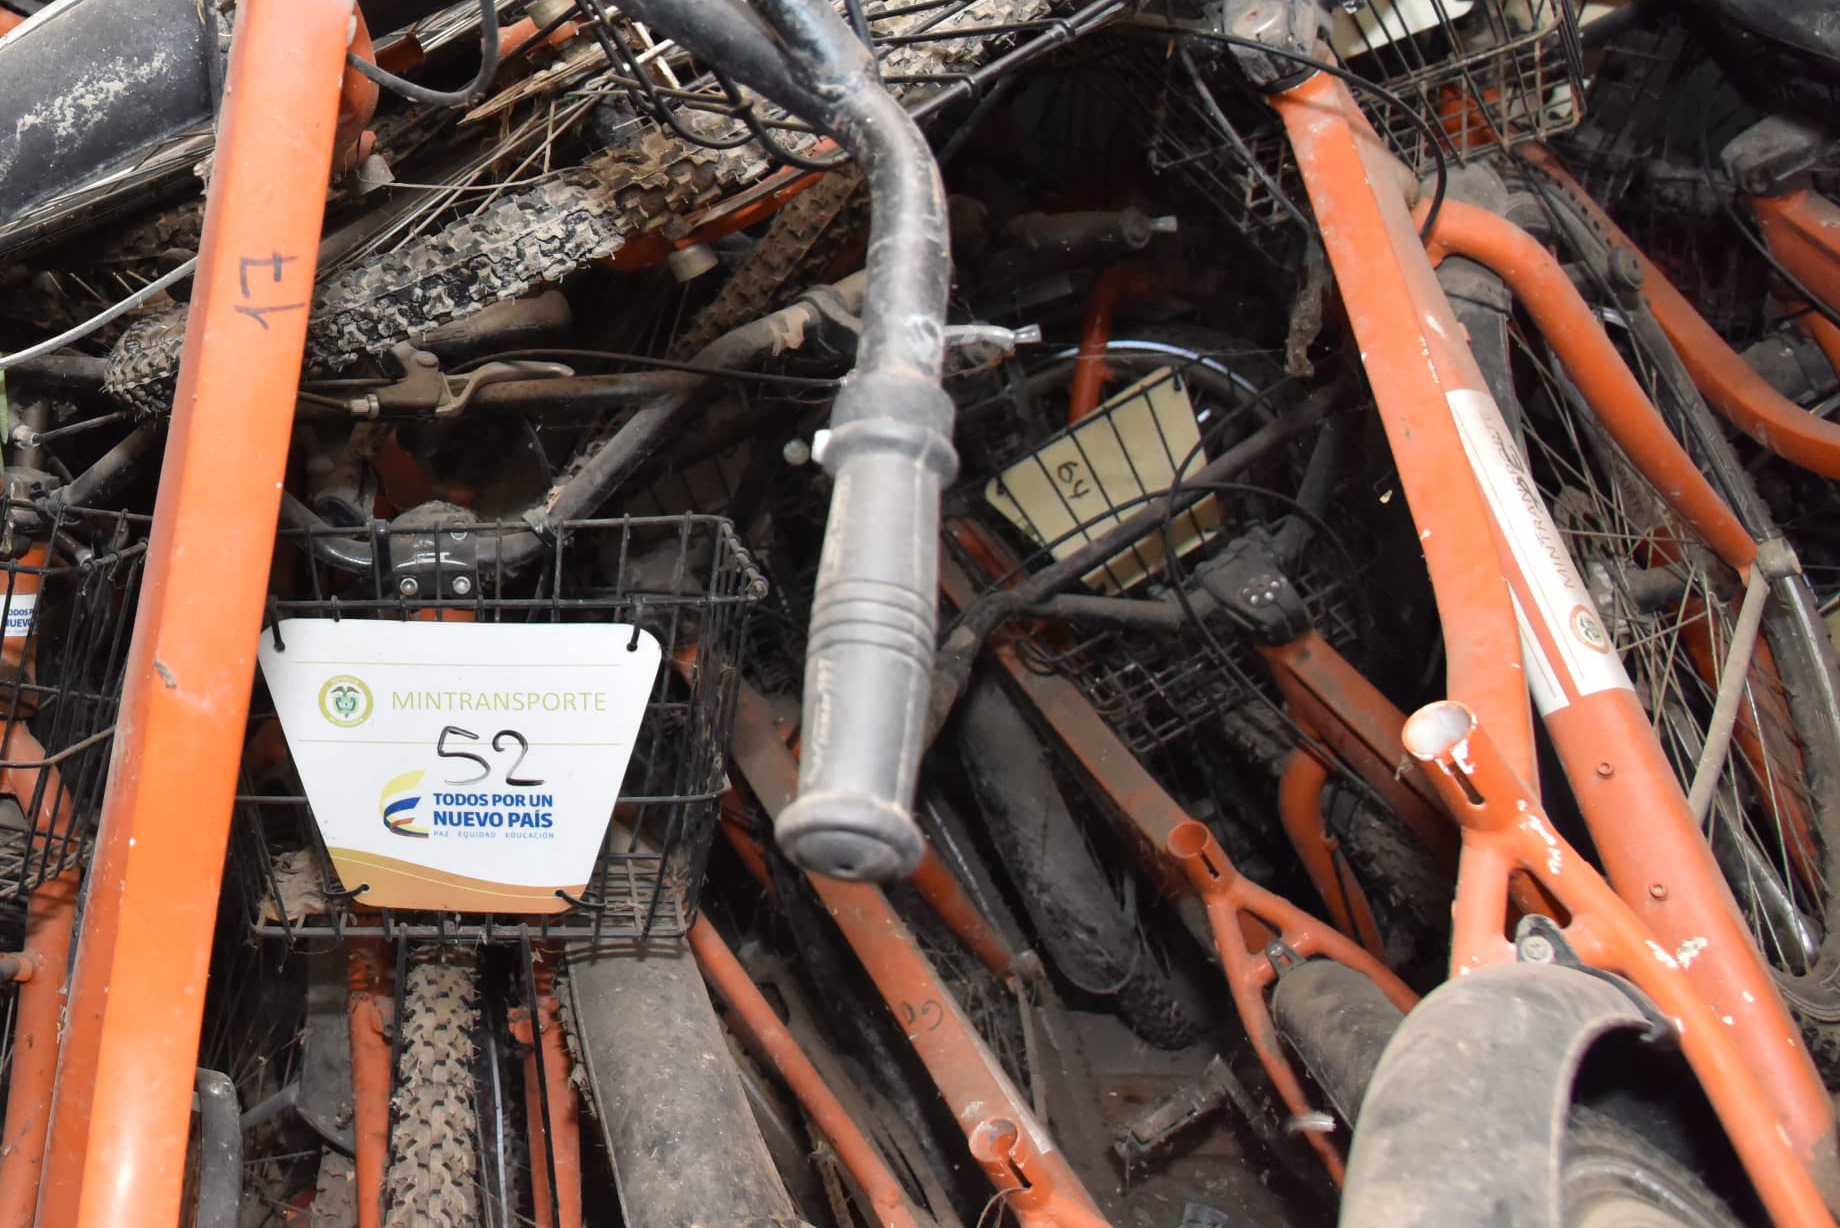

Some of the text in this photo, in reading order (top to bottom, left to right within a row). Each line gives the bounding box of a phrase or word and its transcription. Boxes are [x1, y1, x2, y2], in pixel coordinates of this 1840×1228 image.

[391, 690, 607, 712] MINTRANSPORTE
[437, 725, 547, 786] 52
[433, 792, 553, 808] TODOS POR UN
[433, 807, 553, 828] NUEVO PAÍS
[433, 830, 450, 839] PAZ
[457, 831, 497, 840] EQUIDAD
